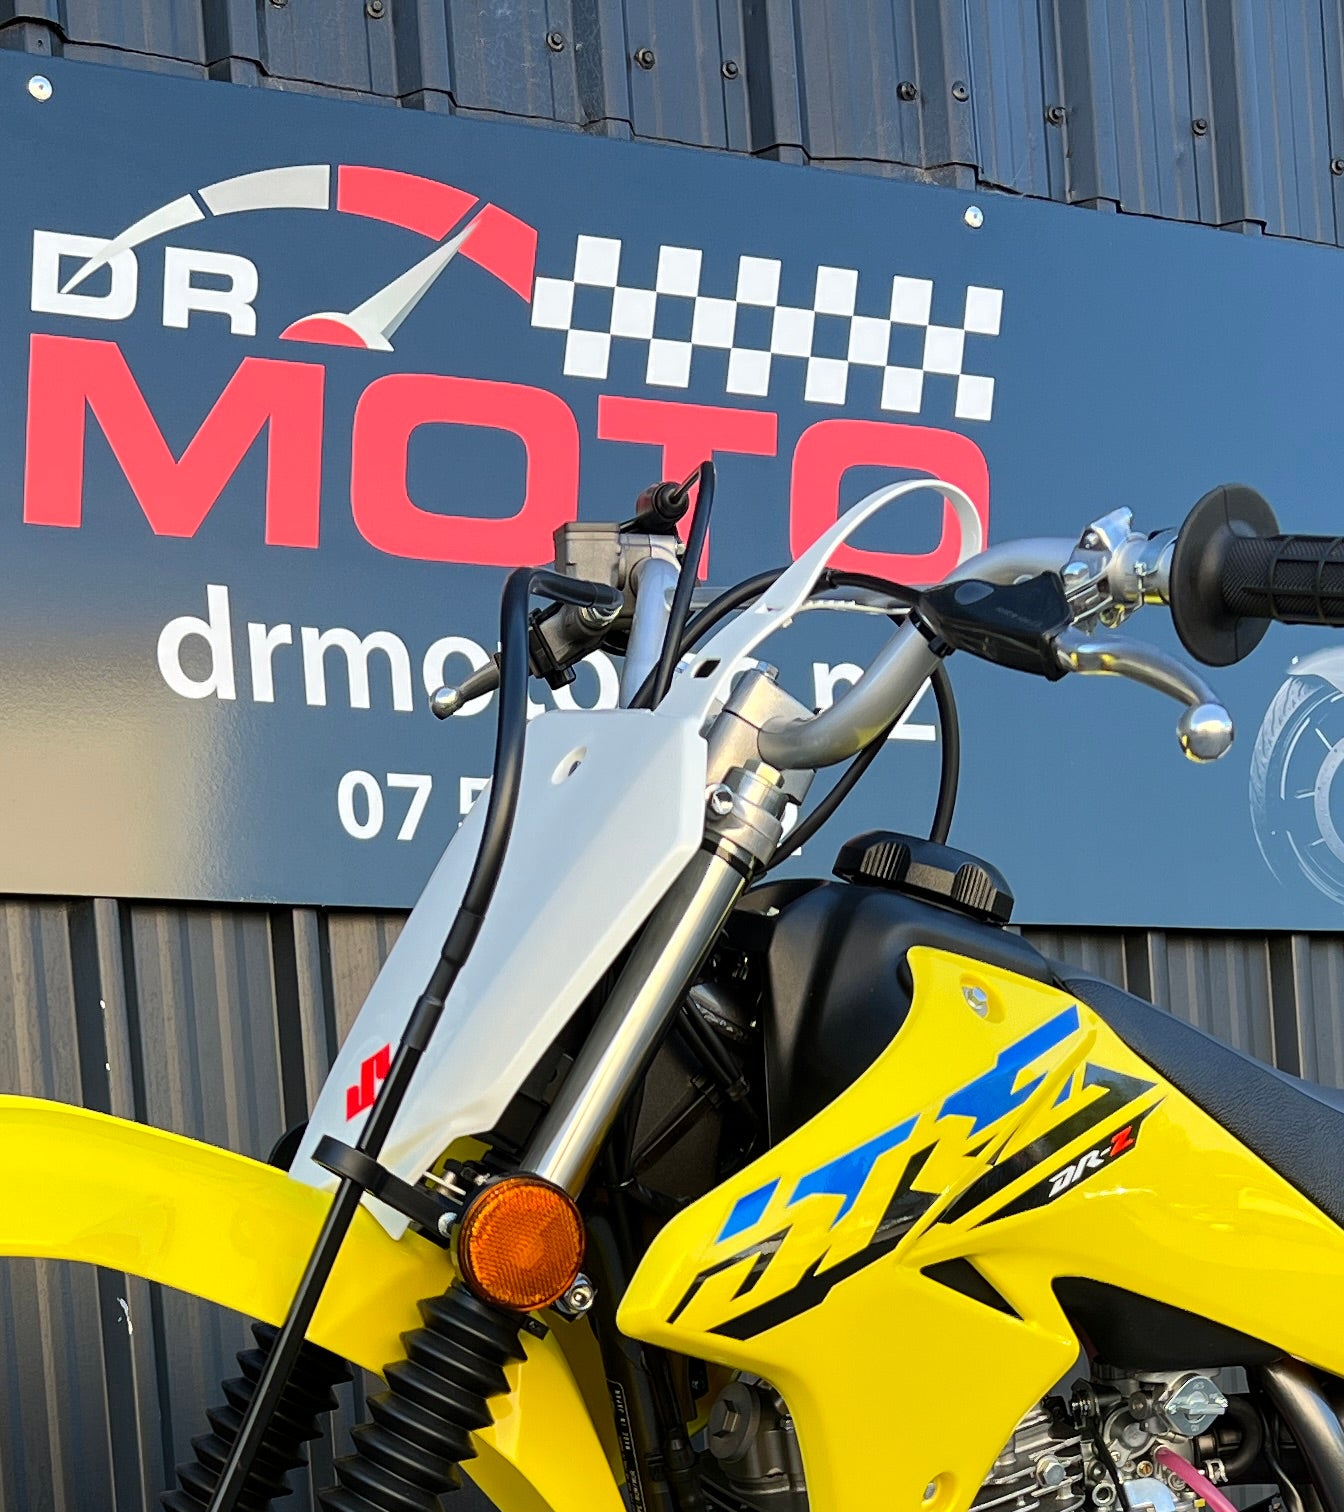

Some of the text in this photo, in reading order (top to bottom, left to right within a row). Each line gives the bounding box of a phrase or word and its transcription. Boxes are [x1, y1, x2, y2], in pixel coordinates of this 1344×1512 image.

[30, 229, 258, 336] DR
[22, 333, 990, 582] MOTO
[337, 769, 433, 841] 07
[1048, 1125, 1135, 1199] DR-Z
